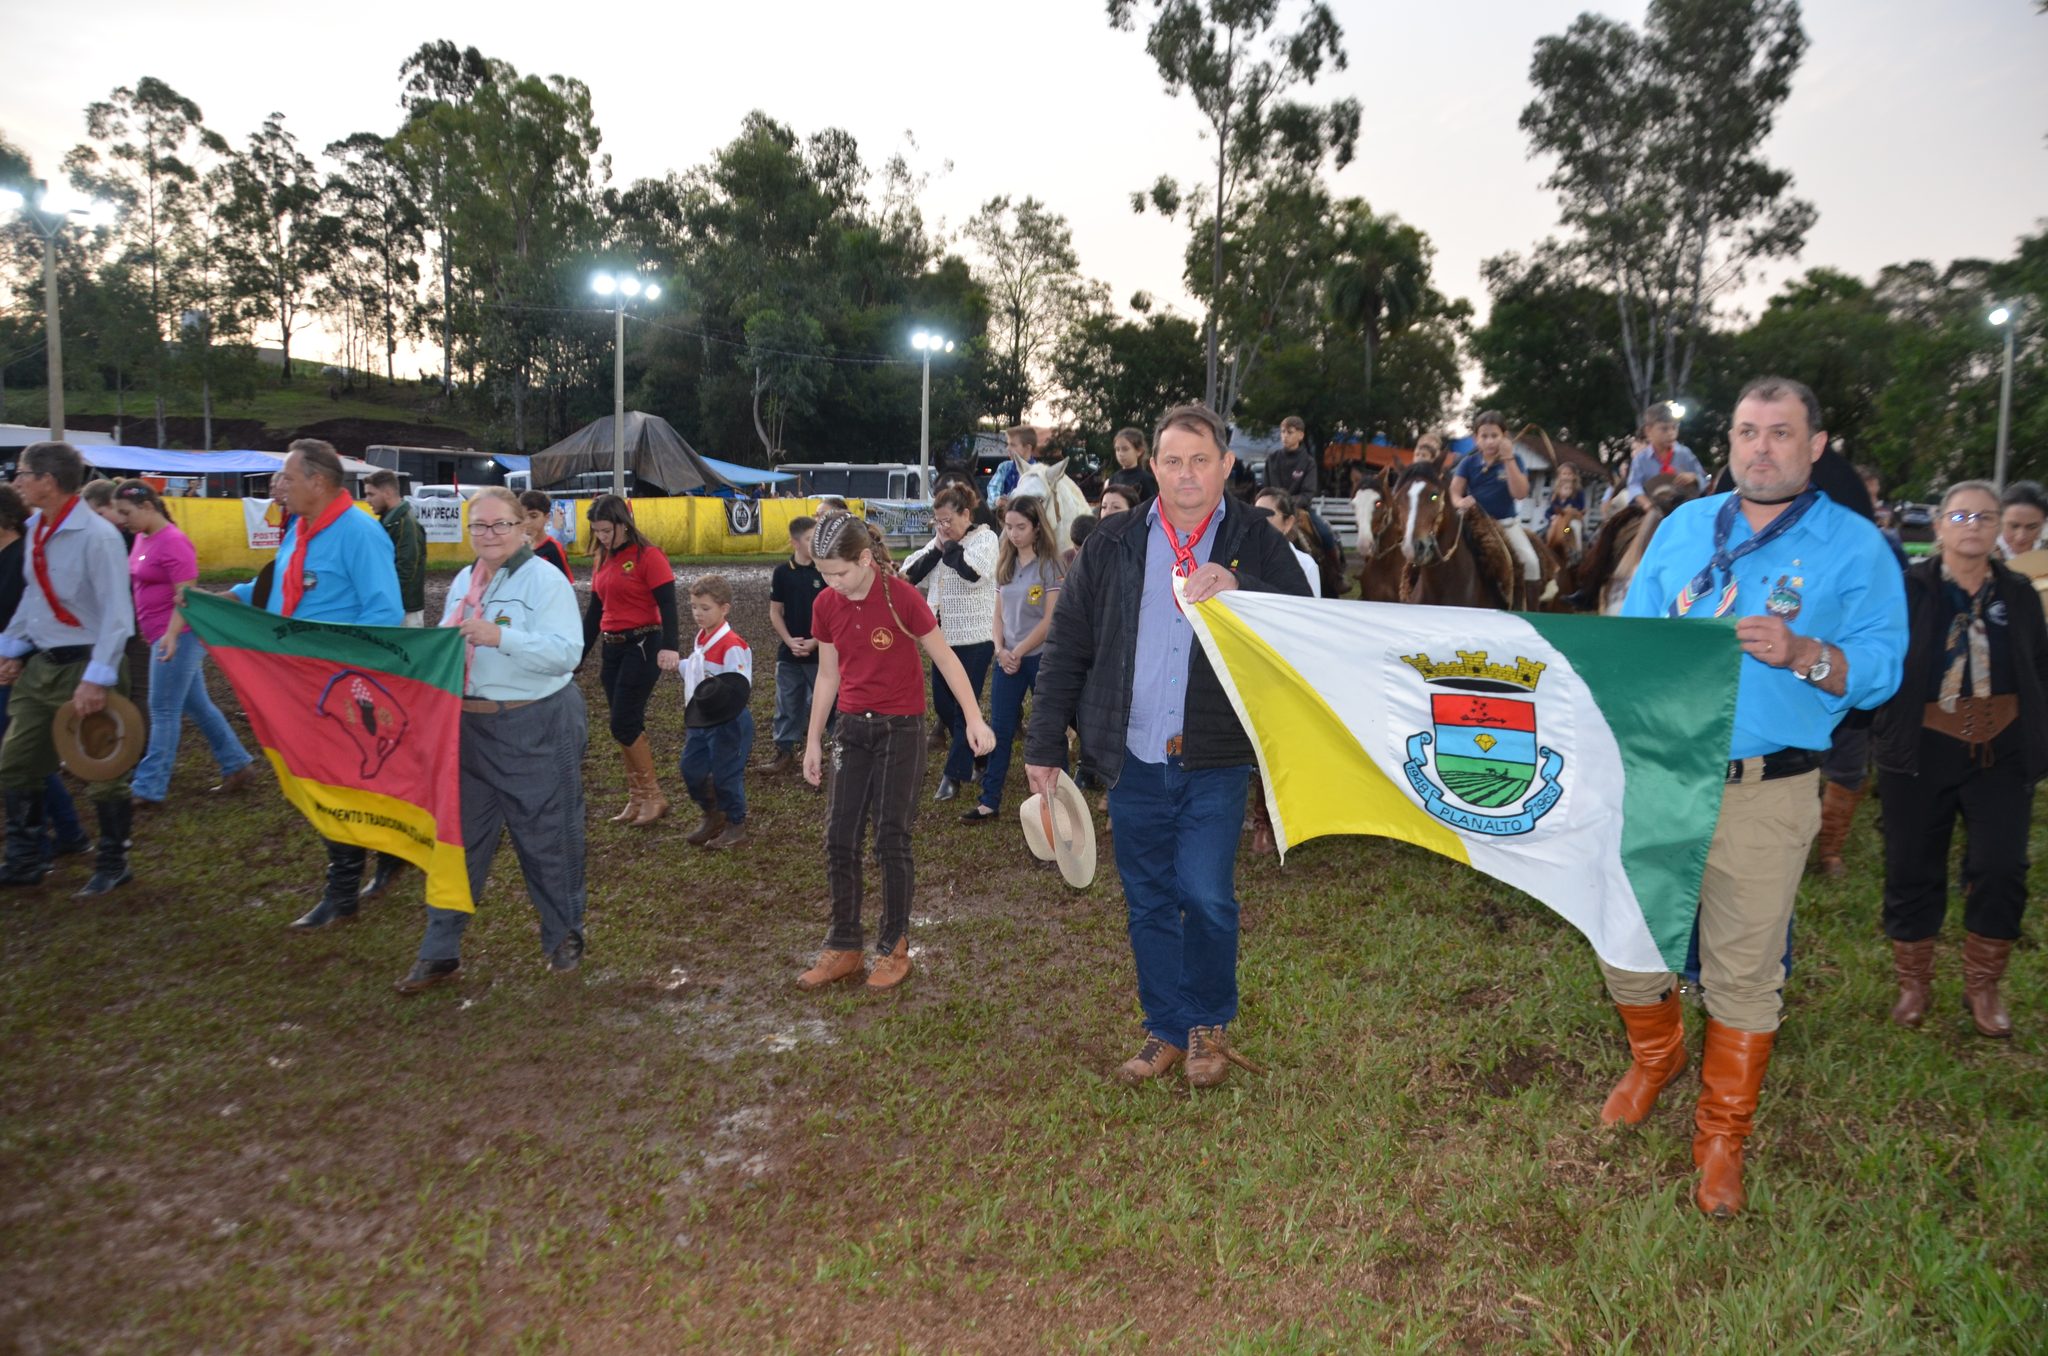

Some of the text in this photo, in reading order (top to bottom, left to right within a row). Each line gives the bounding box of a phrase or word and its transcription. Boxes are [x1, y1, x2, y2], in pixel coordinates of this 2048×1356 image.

[1407, 765, 1559, 832] 1948 PLANALTO 1963
